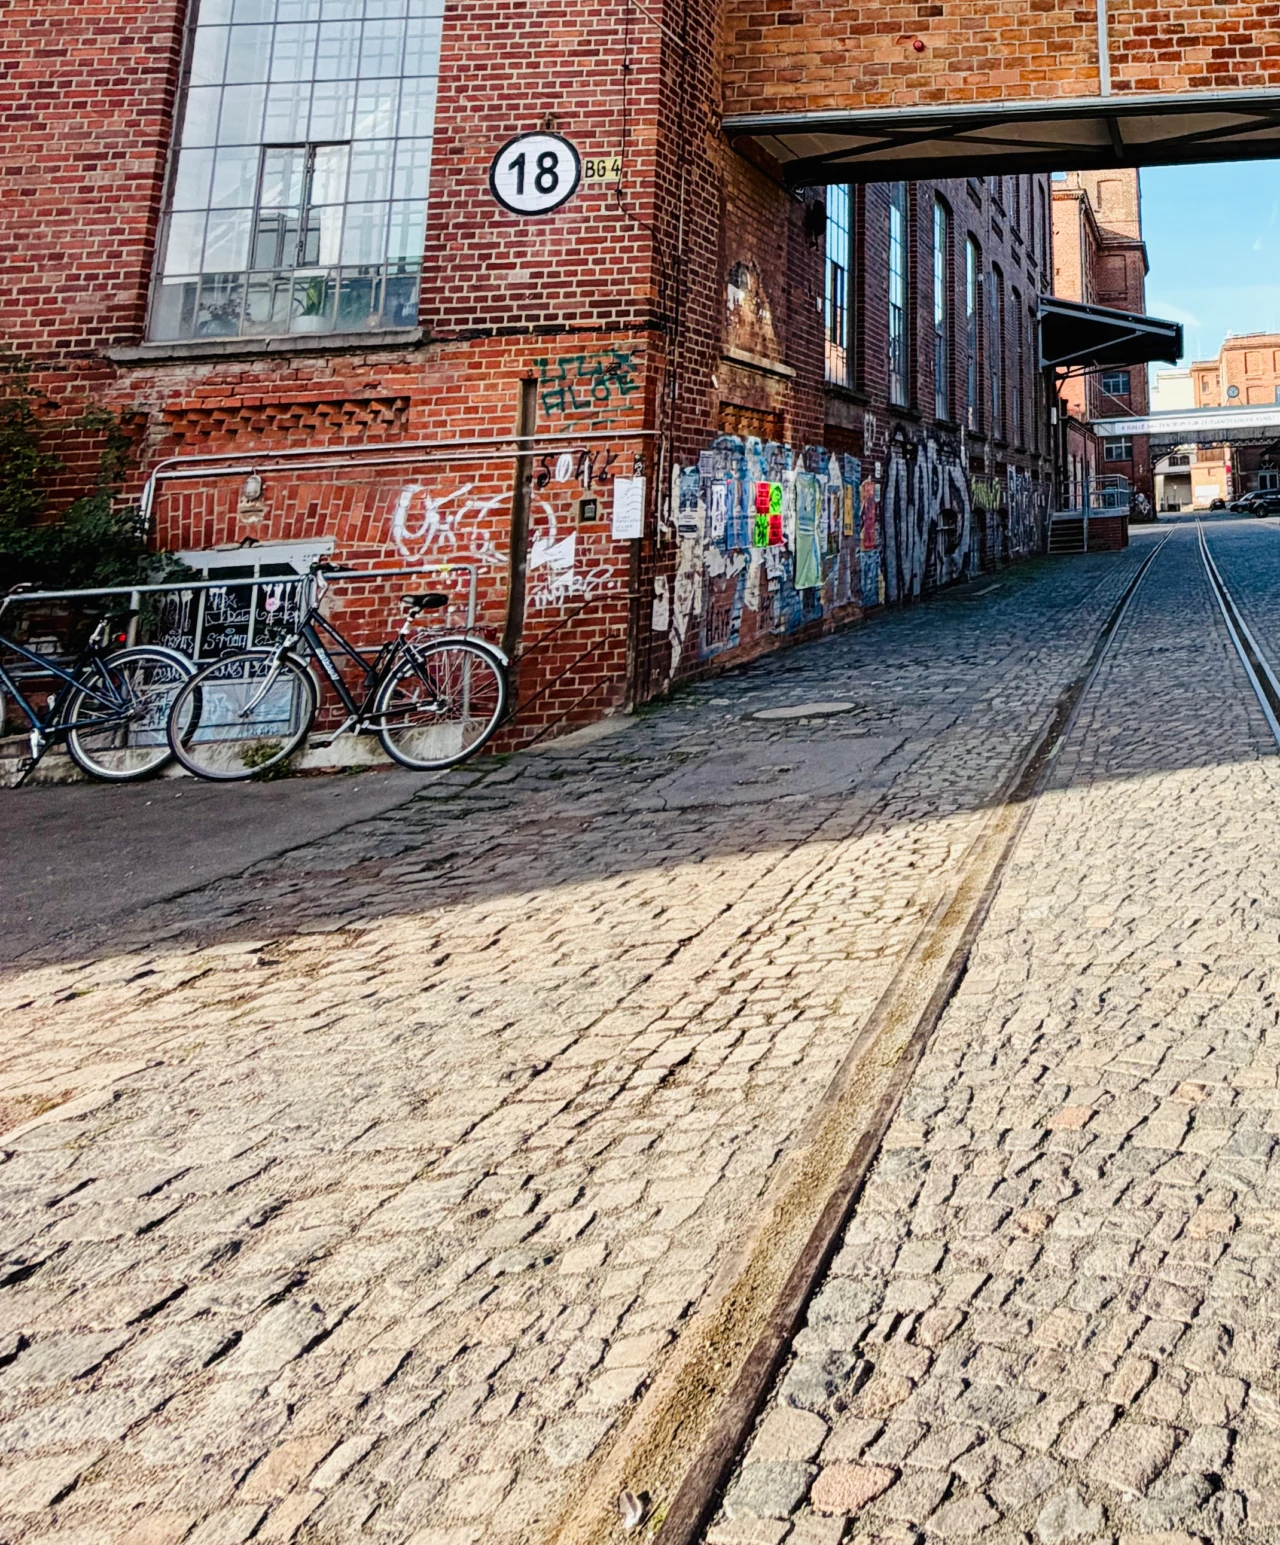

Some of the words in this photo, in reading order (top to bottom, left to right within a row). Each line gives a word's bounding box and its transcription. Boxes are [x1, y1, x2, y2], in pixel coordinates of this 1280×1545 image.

[508, 151, 559, 195] 18
[585, 159, 607, 178] BG
[611, 159, 621, 177] 4
